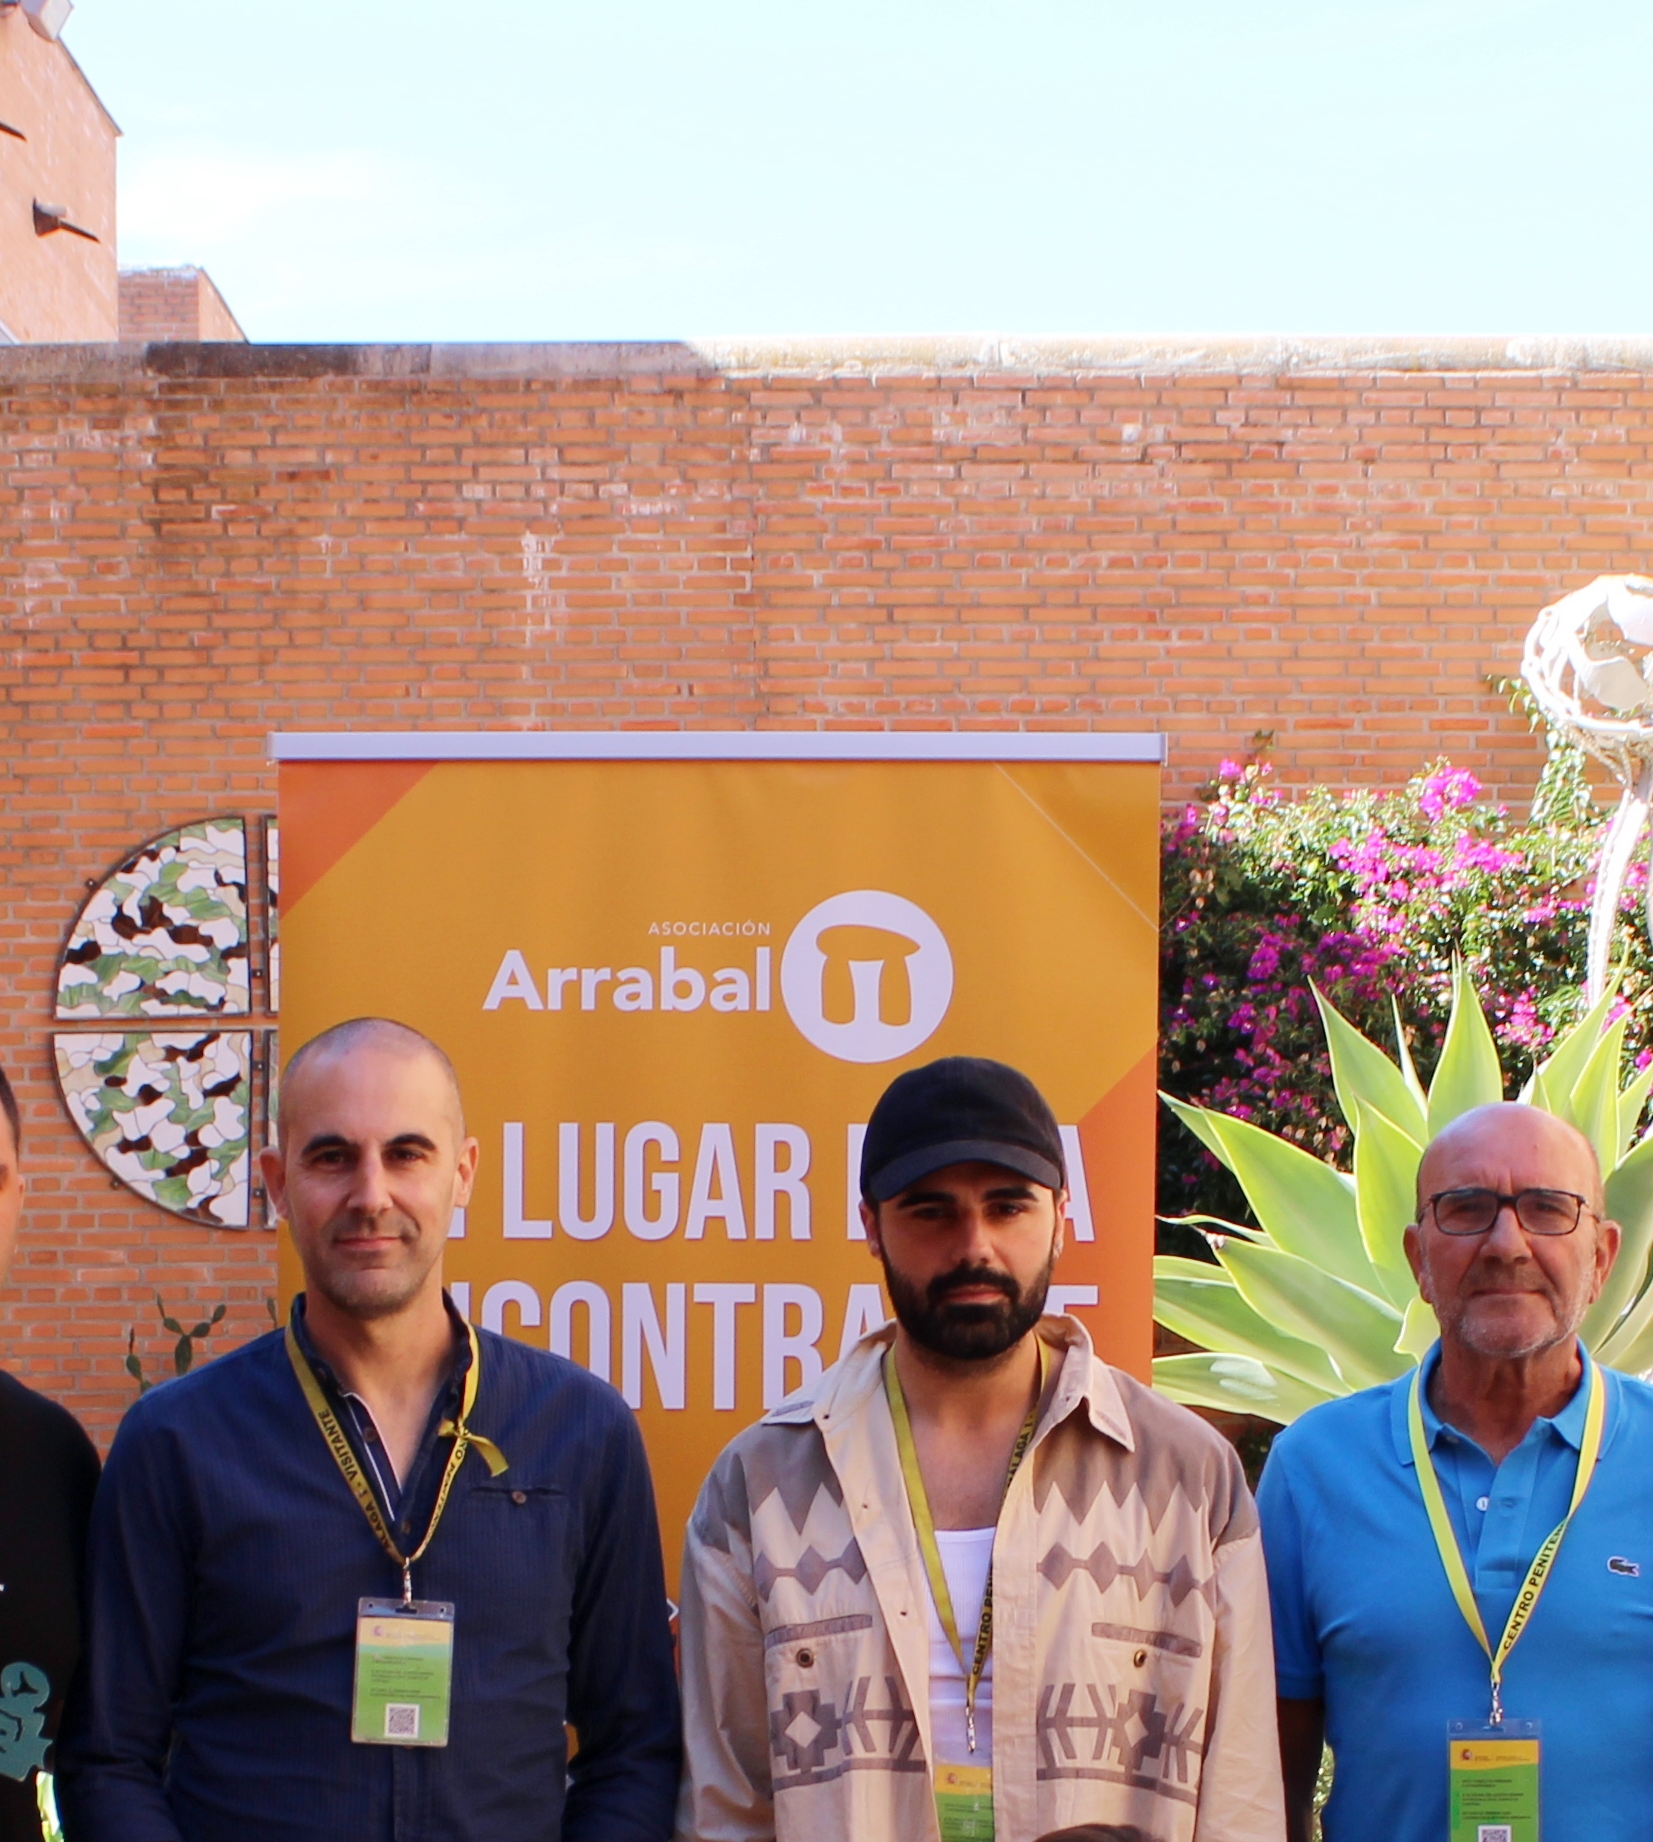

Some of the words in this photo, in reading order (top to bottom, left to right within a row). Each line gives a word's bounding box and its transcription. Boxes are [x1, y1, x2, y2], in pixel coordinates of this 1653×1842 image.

[648, 919, 771, 937] ASOCIACIÓN
[482, 946, 771, 1012] Arrabal
[502, 1121, 812, 1241] LUGAR
[318, 1409, 358, 1481] VISITANTE
[972, 1612, 992, 1676] CENTRO
[1503, 1590, 1535, 1650] CENTRO
